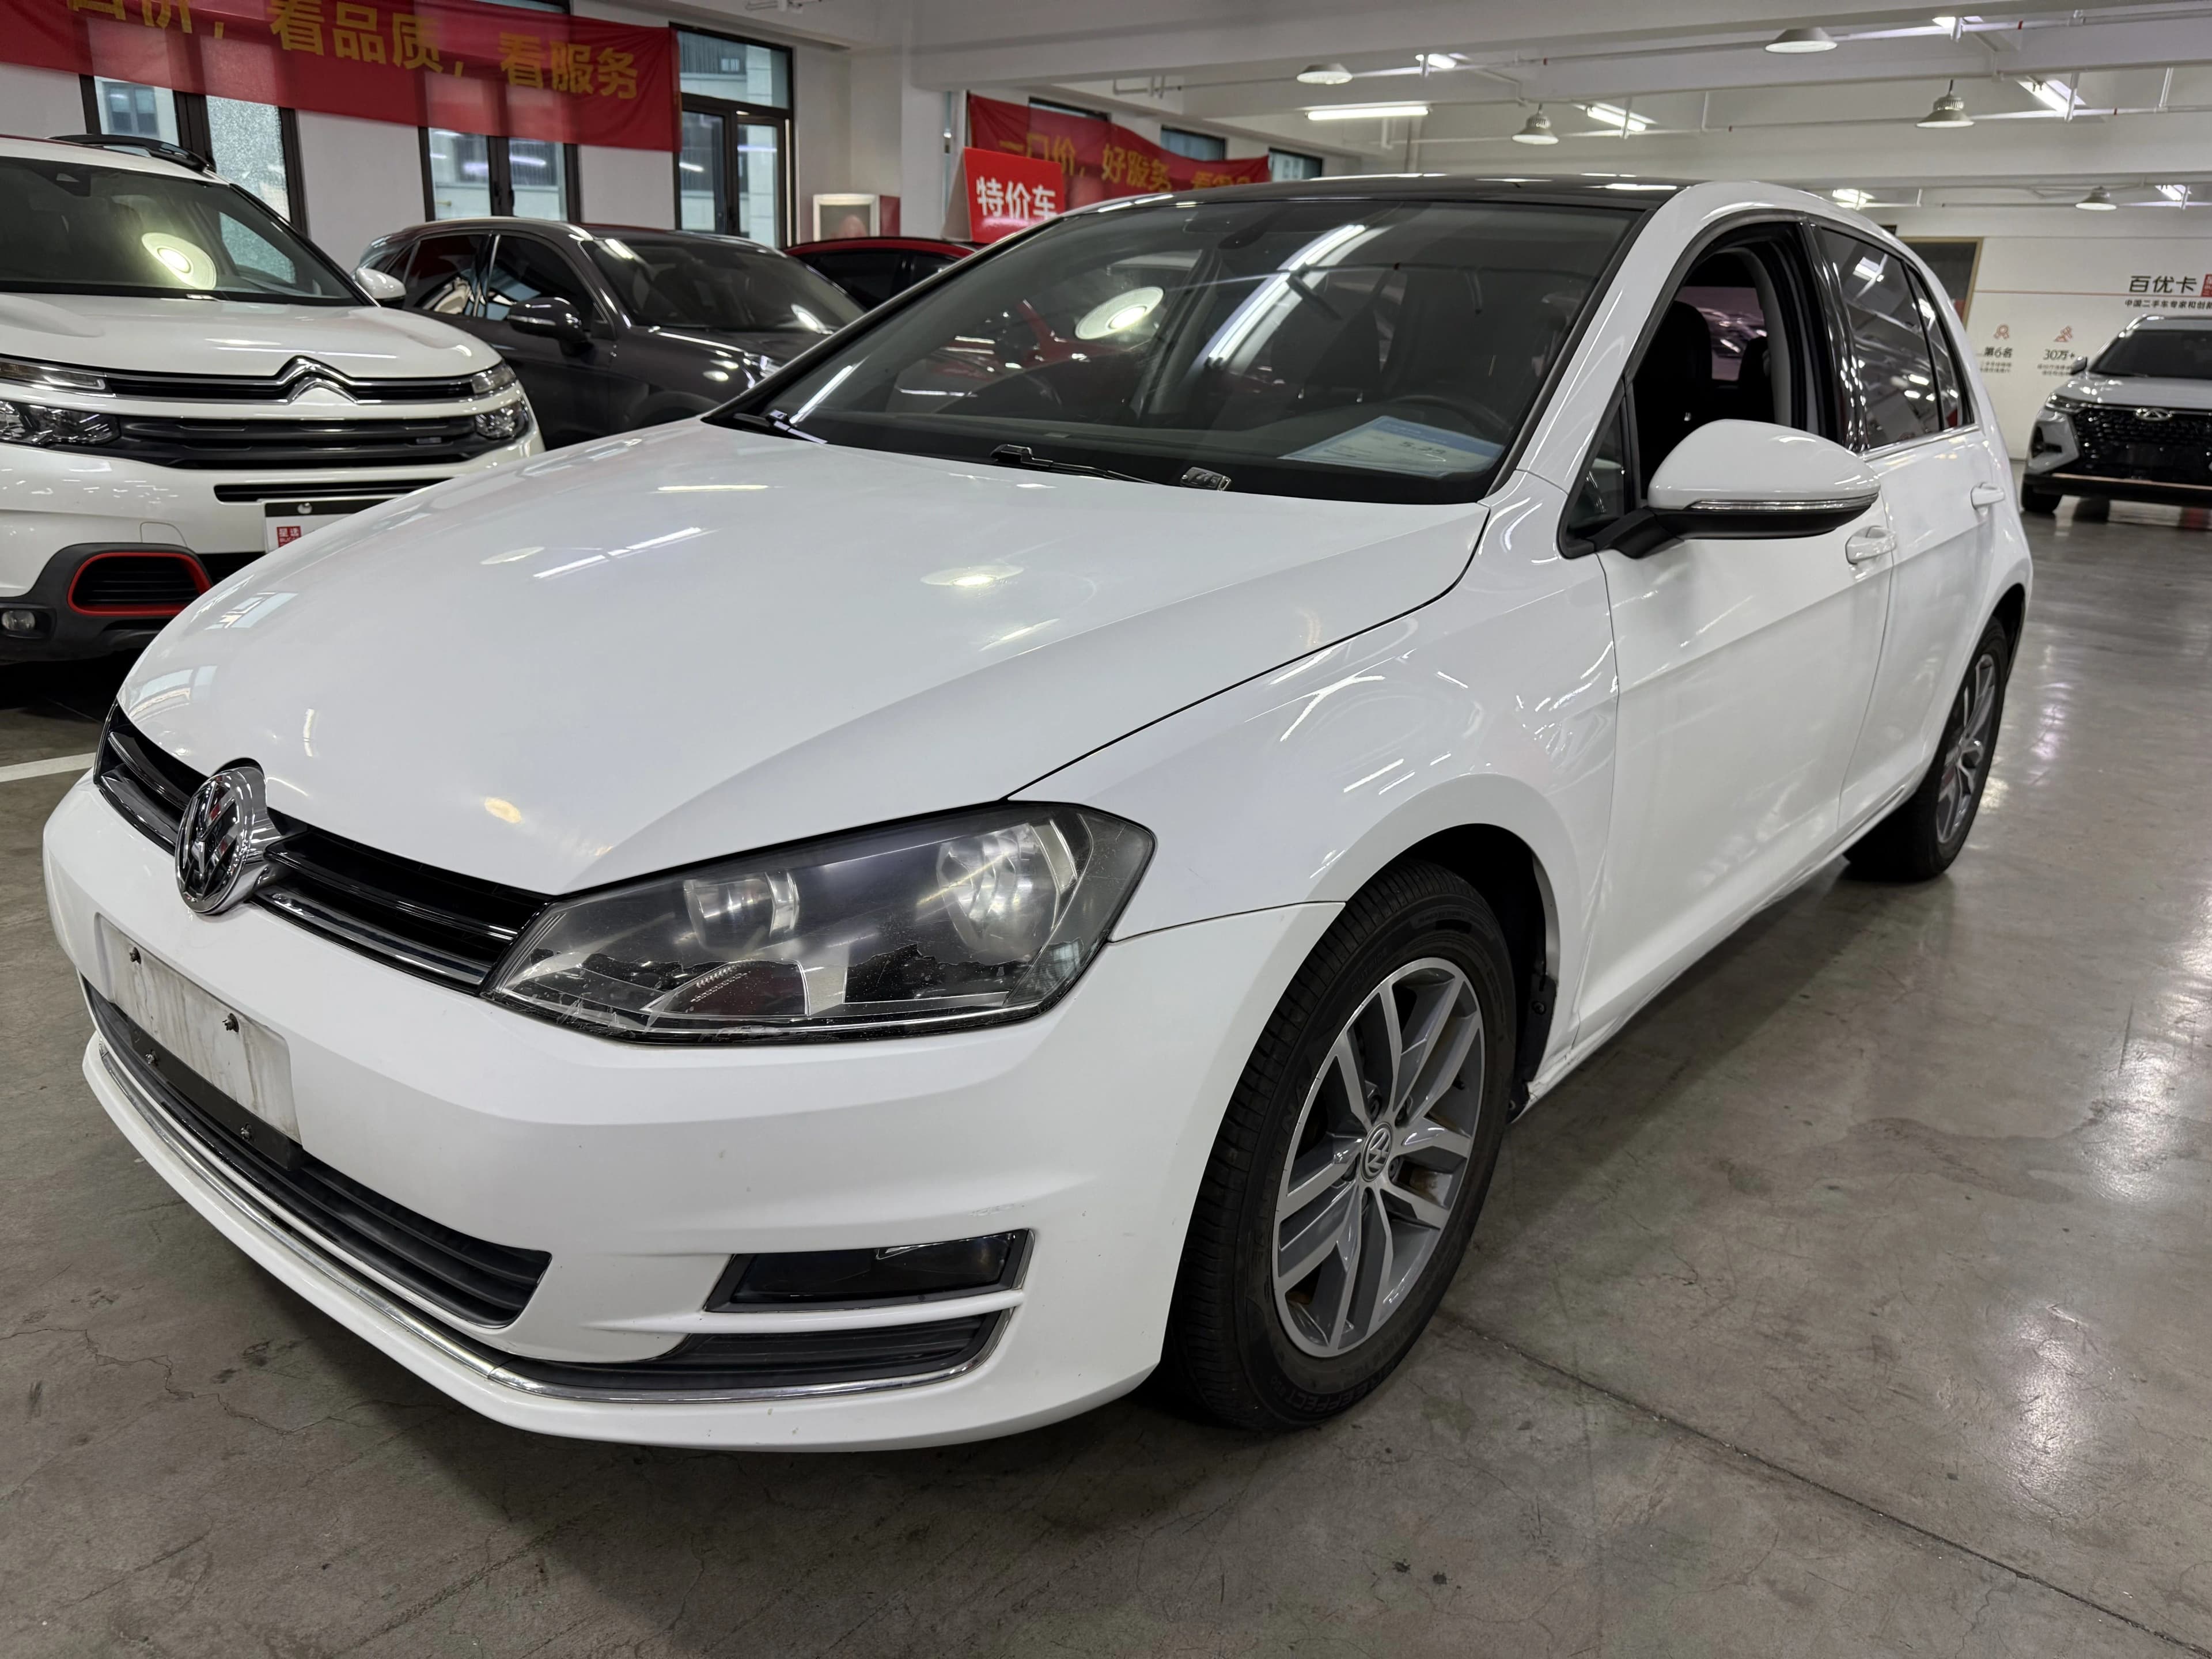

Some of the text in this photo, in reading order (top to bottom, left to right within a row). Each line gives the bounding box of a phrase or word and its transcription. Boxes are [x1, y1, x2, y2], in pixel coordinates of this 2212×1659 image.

[976, 176, 1057, 221] 特价车
[2129, 275, 2197, 294] 百优卡
